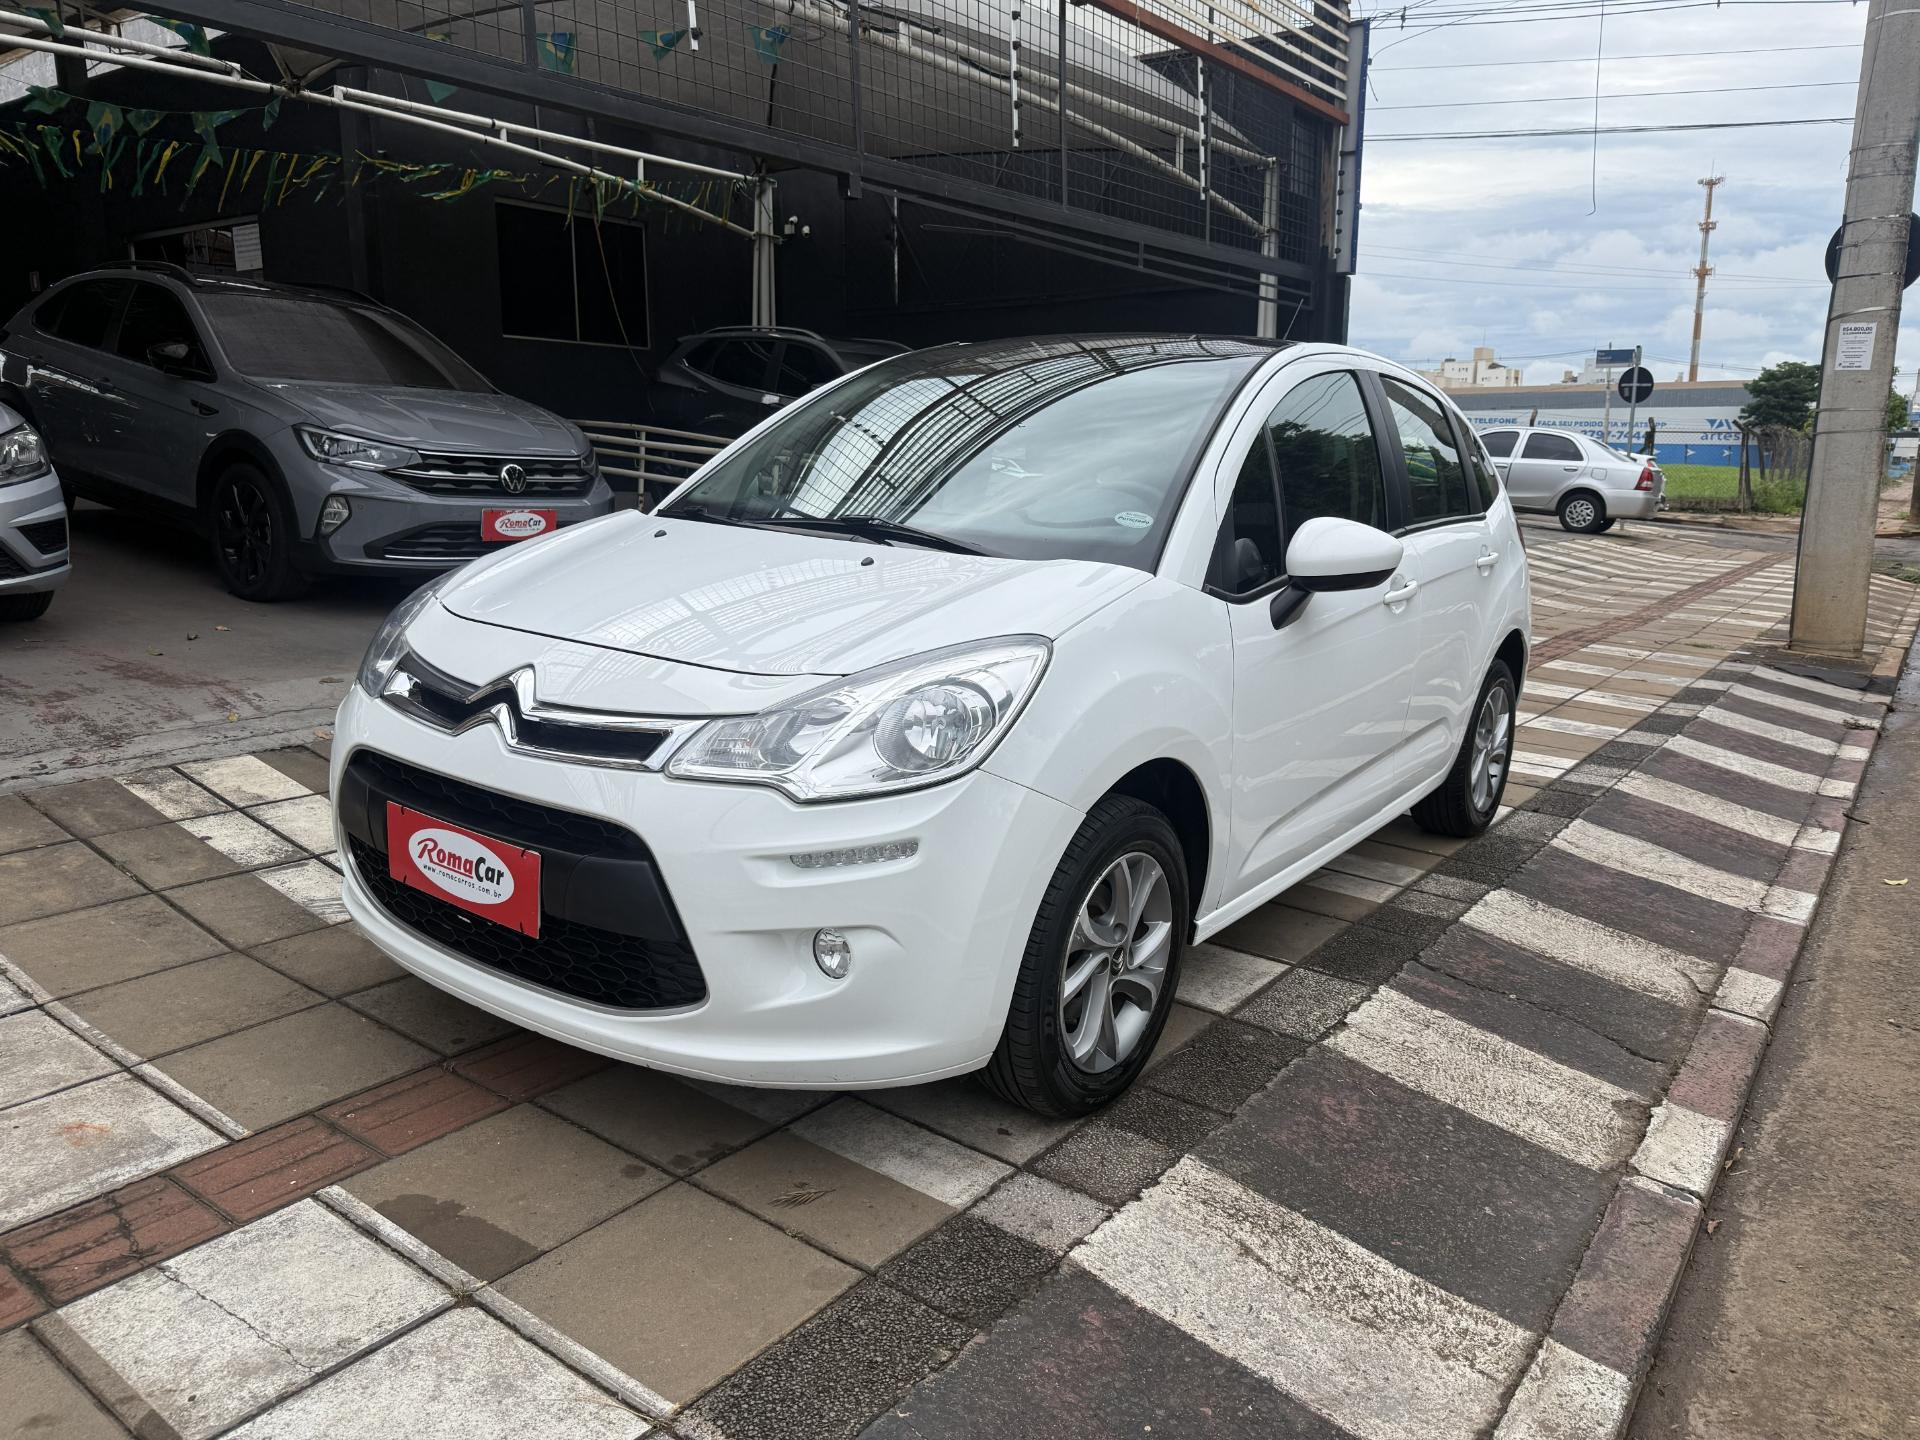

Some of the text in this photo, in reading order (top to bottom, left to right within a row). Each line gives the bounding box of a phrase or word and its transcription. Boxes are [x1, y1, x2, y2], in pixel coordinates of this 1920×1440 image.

[1474, 417, 1517, 425] TELEFONE
[1621, 421, 1667, 429] WATSPP
[499, 517, 542, 529] RomaCar
[417, 837, 505, 886] RomaCar
